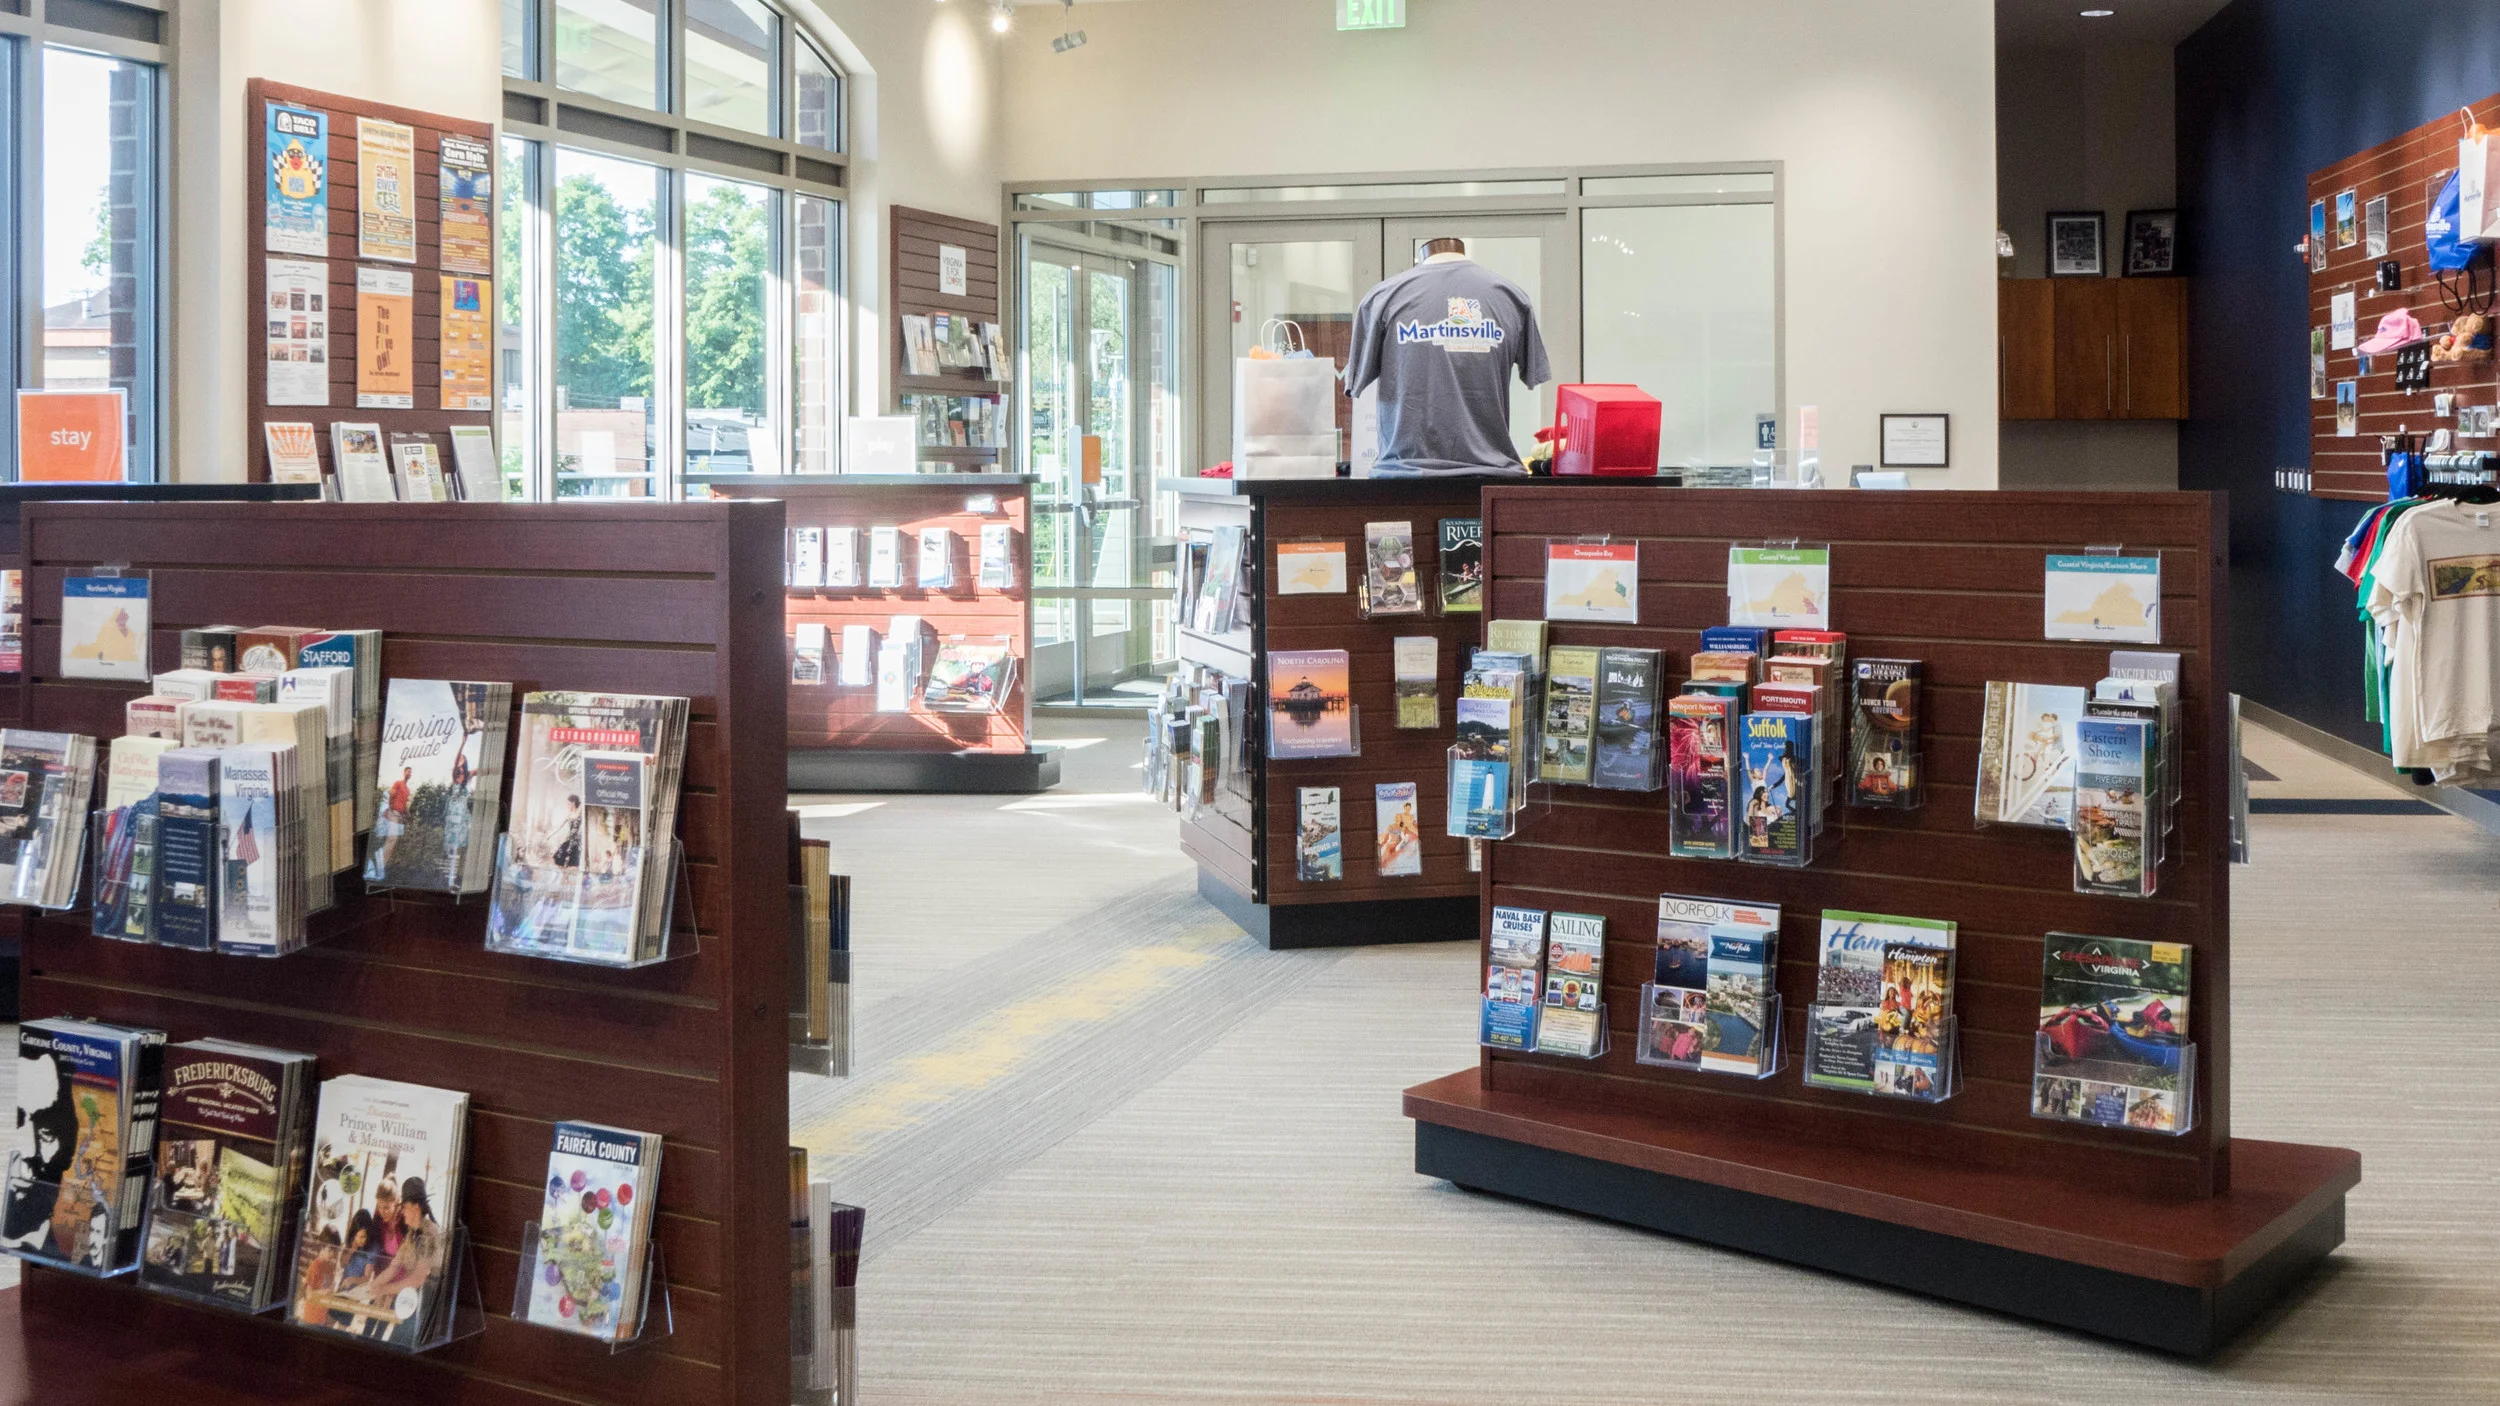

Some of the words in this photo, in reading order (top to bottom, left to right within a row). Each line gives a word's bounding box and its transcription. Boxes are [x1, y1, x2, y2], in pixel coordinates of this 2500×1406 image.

[1347, 0, 1394, 24] EXIT
[293, 117, 316, 127] TACO
[293, 125, 316, 136] BELL
[444, 147, 464, 160] Corn
[465, 150, 485, 162] Hole
[942, 256, 963, 268] VIRGINIA
[376, 305, 390, 320] The
[1399, 321, 1502, 341] Martinsville
[50, 427, 92, 451] stay
[1574, 549, 1604, 558] Chesapeake
[1605, 550, 1613, 559] Bay
[1759, 553, 1779, 561] Coastal
[1780, 554, 1801, 562] Virginia
[2057, 560, 2080, 568] Coastal
[2130, 562, 2147, 570] Shore
[1490, 626, 1539, 639] RICHMOND
[1491, 640, 1537, 650] COUNTY
[304, 650, 350, 663] STAFFORD
[1277, 657, 1304, 665] NORTH
[1307, 657, 1344, 665] CAROLINA
[2112, 667, 2146, 681] TANGIER
[2146, 668, 2174, 683] ISLAND
[1761, 695, 1806, 705] PORTSMOUTH
[1860, 698, 1881, 706] LAUNCH
[1882, 699, 1897, 707] YOUR
[1670, 702, 1698, 713] Newport
[1699, 703, 1717, 712] News
[1871, 706, 1903, 715] ADVENTURE
[384, 714, 457, 745] touring
[1748, 718, 1787, 738] Suffolk
[553, 731, 637, 743] EXTRAORDINARY
[2083, 730, 2127, 745] Eastern
[399, 739, 441, 767] guide
[2088, 744, 2122, 759] Shore
[224, 766, 270, 782] Manassas,
[2095, 775, 2110, 783] FIVE
[2111, 776, 2136, 784] GREAT
[235, 784, 269, 799] Virginia
[595, 789, 616, 799] Official
[616, 789, 630, 800] Map
[2103, 811, 2136, 819] ARTISAN
[2104, 849, 2135, 859] DOZEN
[1495, 910, 1520, 922] NAVAL
[1522, 913, 1541, 924] BASE
[1666, 901, 1730, 920] NORFOLK
[1502, 920, 1533, 932] CRUISES
[1551, 917, 1600, 938] SAILING
[1725, 942, 1751, 953] Norfolk
[1888, 948, 1937, 964] Hampton
[2062, 951, 2141, 968] CHESAPEAKE
[2092, 964, 2140, 977] VIRGINIA
[20, 1032, 51, 1047] CAROLINE
[52, 1038, 82, 1056] COUNTY,
[82, 1044, 112, 1061] VIRGINIA
[174, 1062, 277, 1102] FREDERICKSBURG
[340, 1113, 377, 1133] Prince
[381, 1119, 428, 1141] William
[348, 1132, 358, 1145] &
[360, 1132, 416, 1153] Manassas
[556, 1135, 597, 1157] FAIRFAX
[598, 1142, 637, 1163] COUNTY
